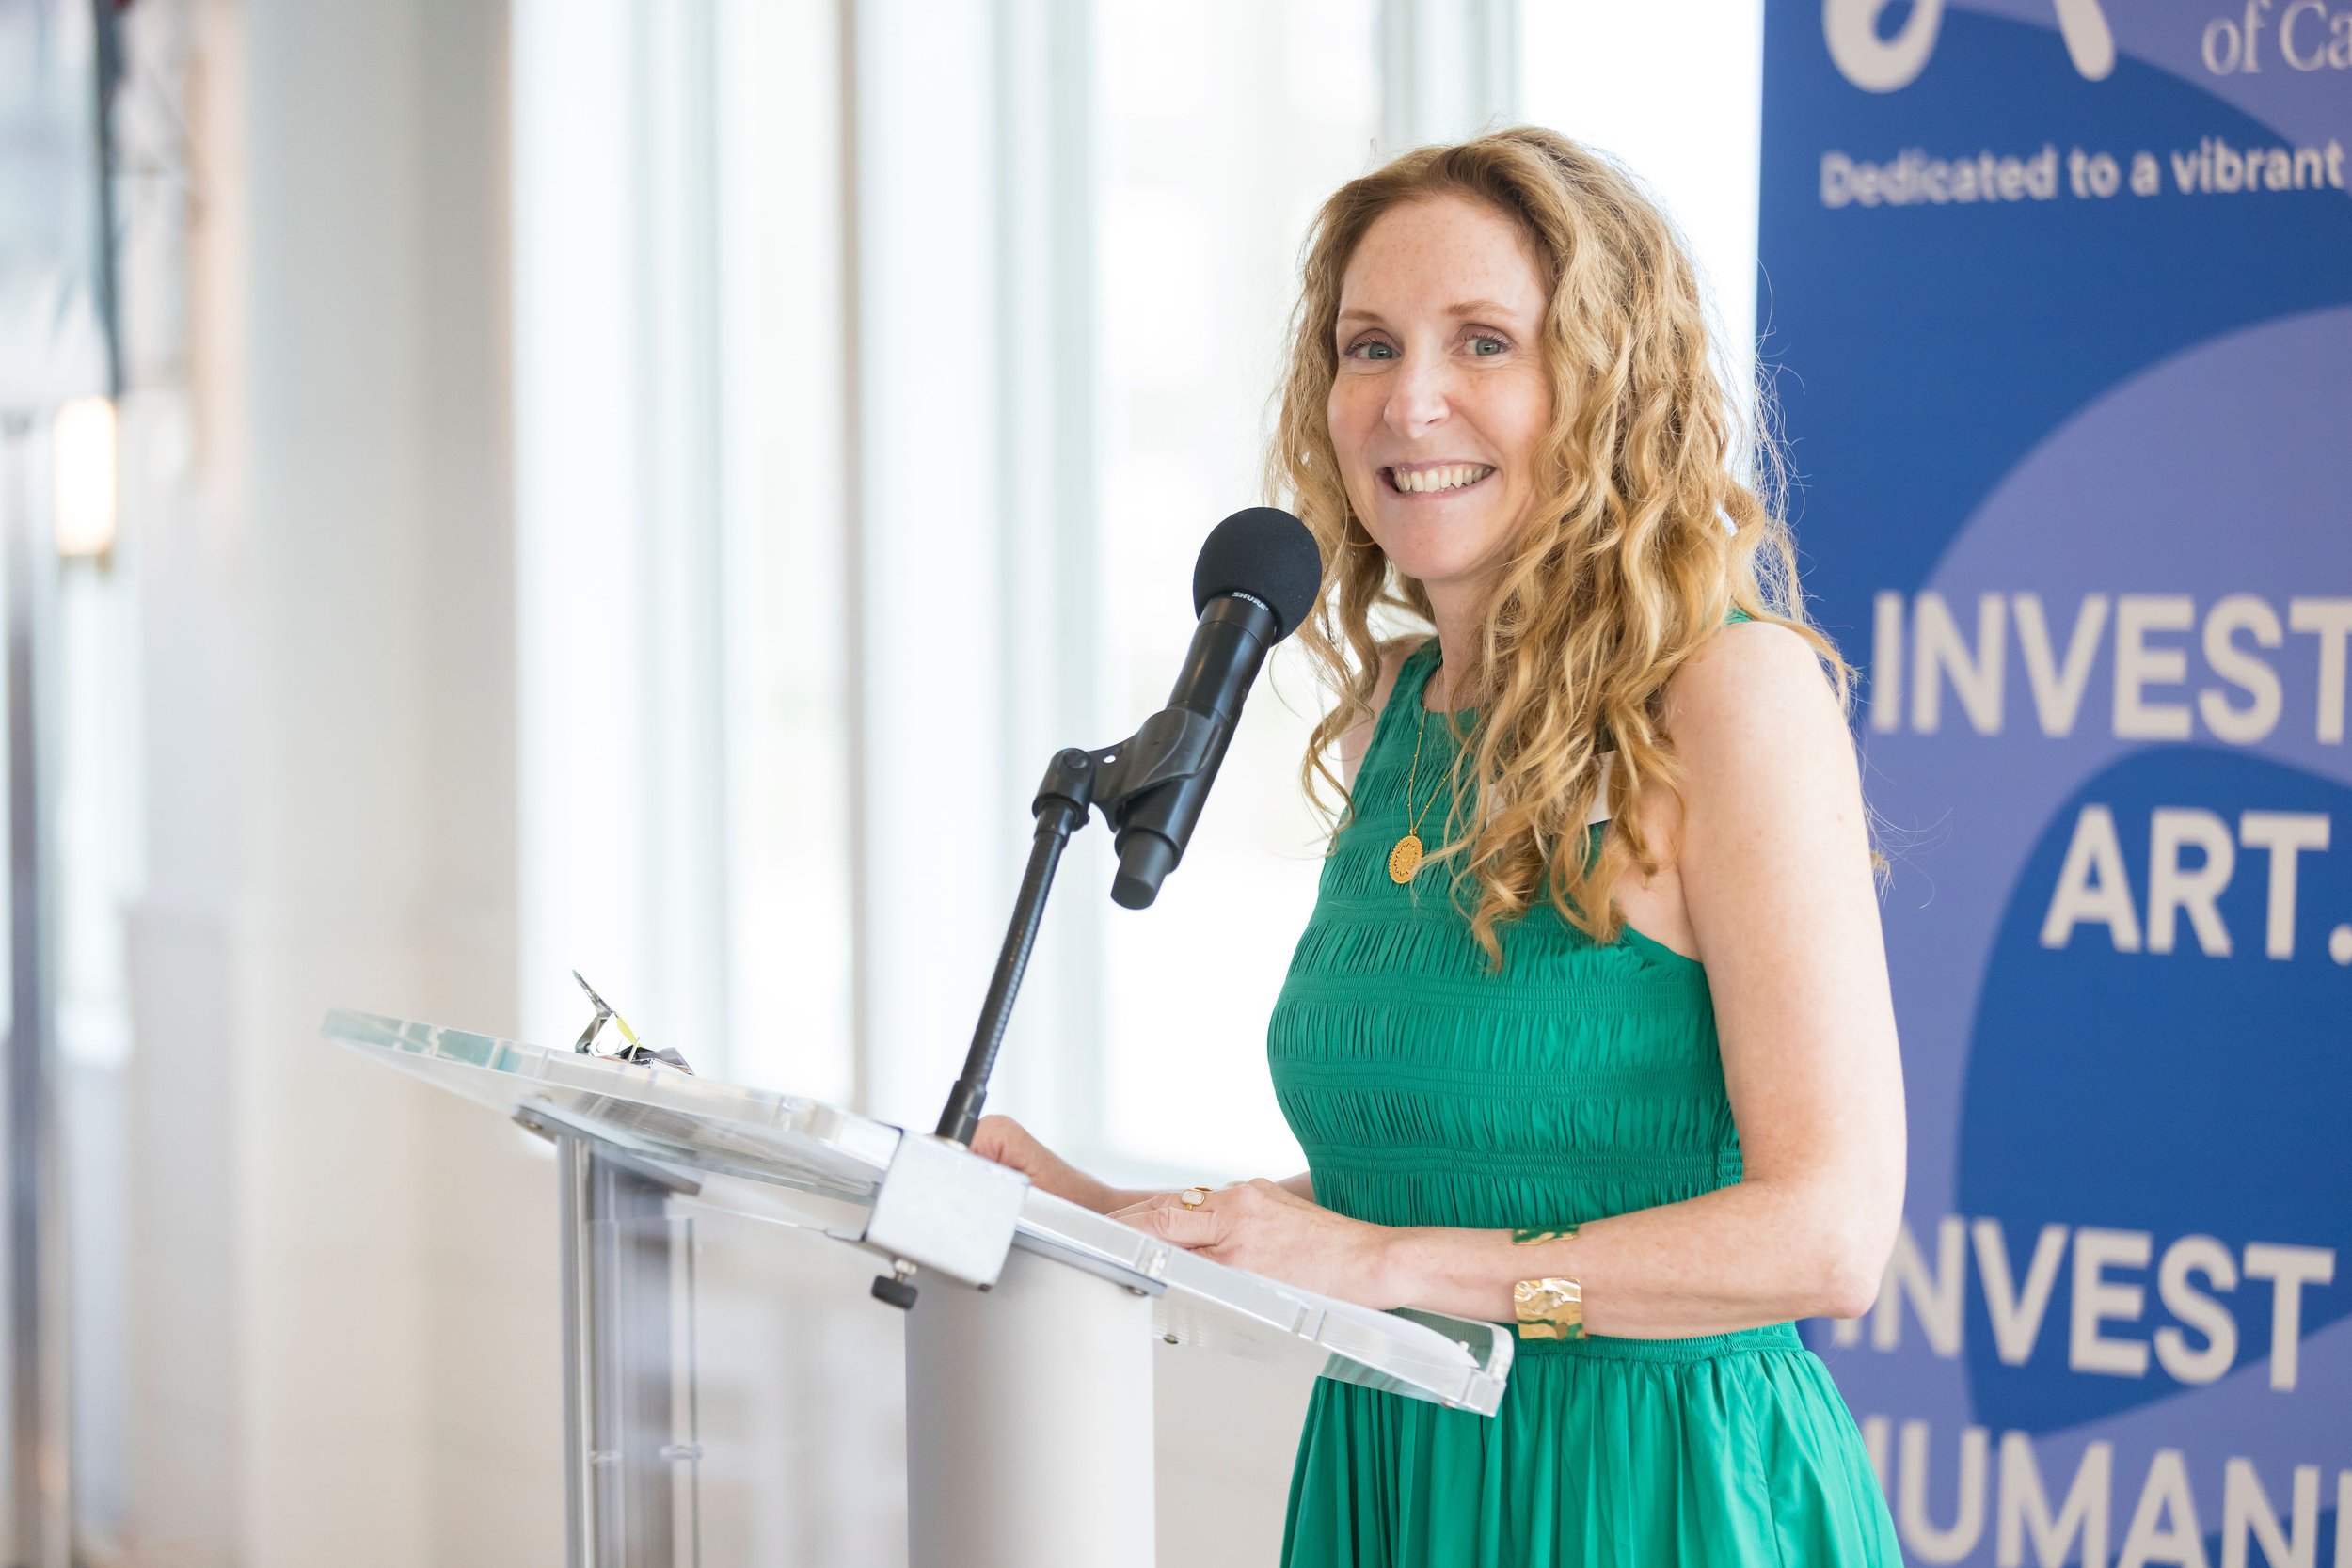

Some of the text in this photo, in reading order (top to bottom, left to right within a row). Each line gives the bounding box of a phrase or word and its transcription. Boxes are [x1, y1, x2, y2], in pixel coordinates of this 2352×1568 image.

[2201, 0, 2272, 76] of
[1820, 136, 2345, 209] Dedicated to a vibrant
[1232, 591, 1266, 611] SHURE
[1871, 591, 2352, 746] INVEST
[2039, 805, 2352, 966] ART.
[1831, 1214, 2336, 1392] NVEST
